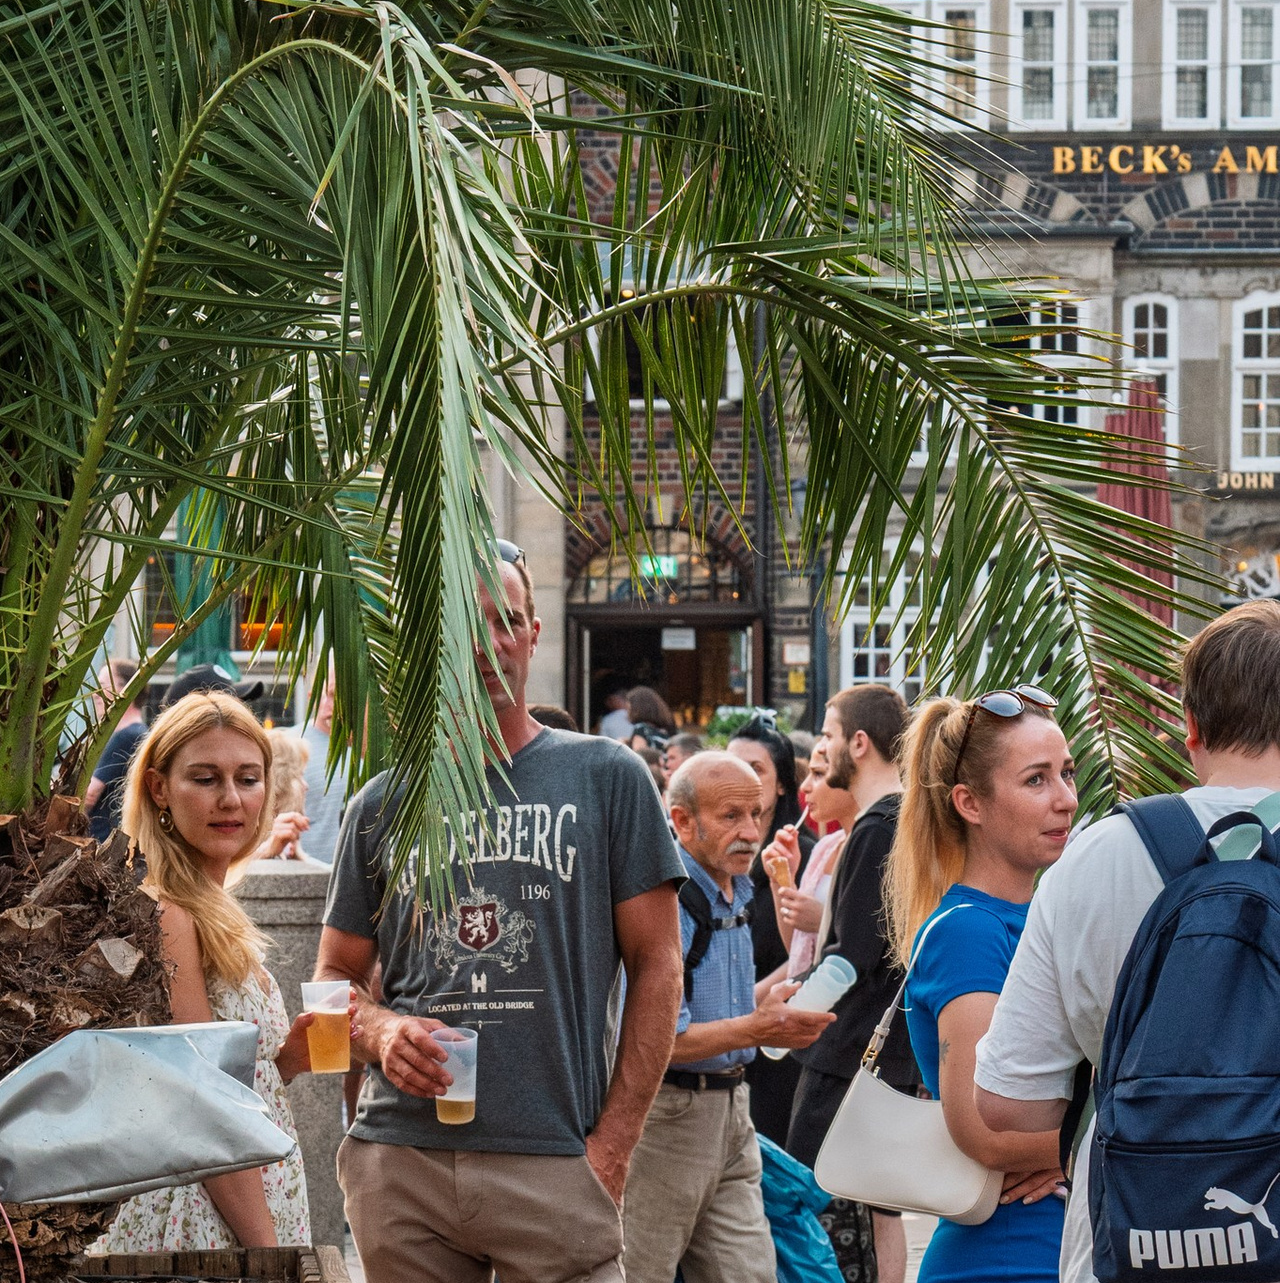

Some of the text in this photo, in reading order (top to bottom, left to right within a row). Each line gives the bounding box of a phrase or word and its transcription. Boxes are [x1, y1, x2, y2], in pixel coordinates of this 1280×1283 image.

[1052, 144, 1279, 175] BECK's AM
[1217, 472, 1275, 490] JOHN
[520, 884, 551, 900] 1196
[428, 1003, 462, 1013] LOCATED
[462, 1003, 471, 1011] AT
[472, 1002, 488, 1010] THE
[505, 1001, 535, 1009] BRIDGE
[1129, 1221, 1258, 1270] PUMA
